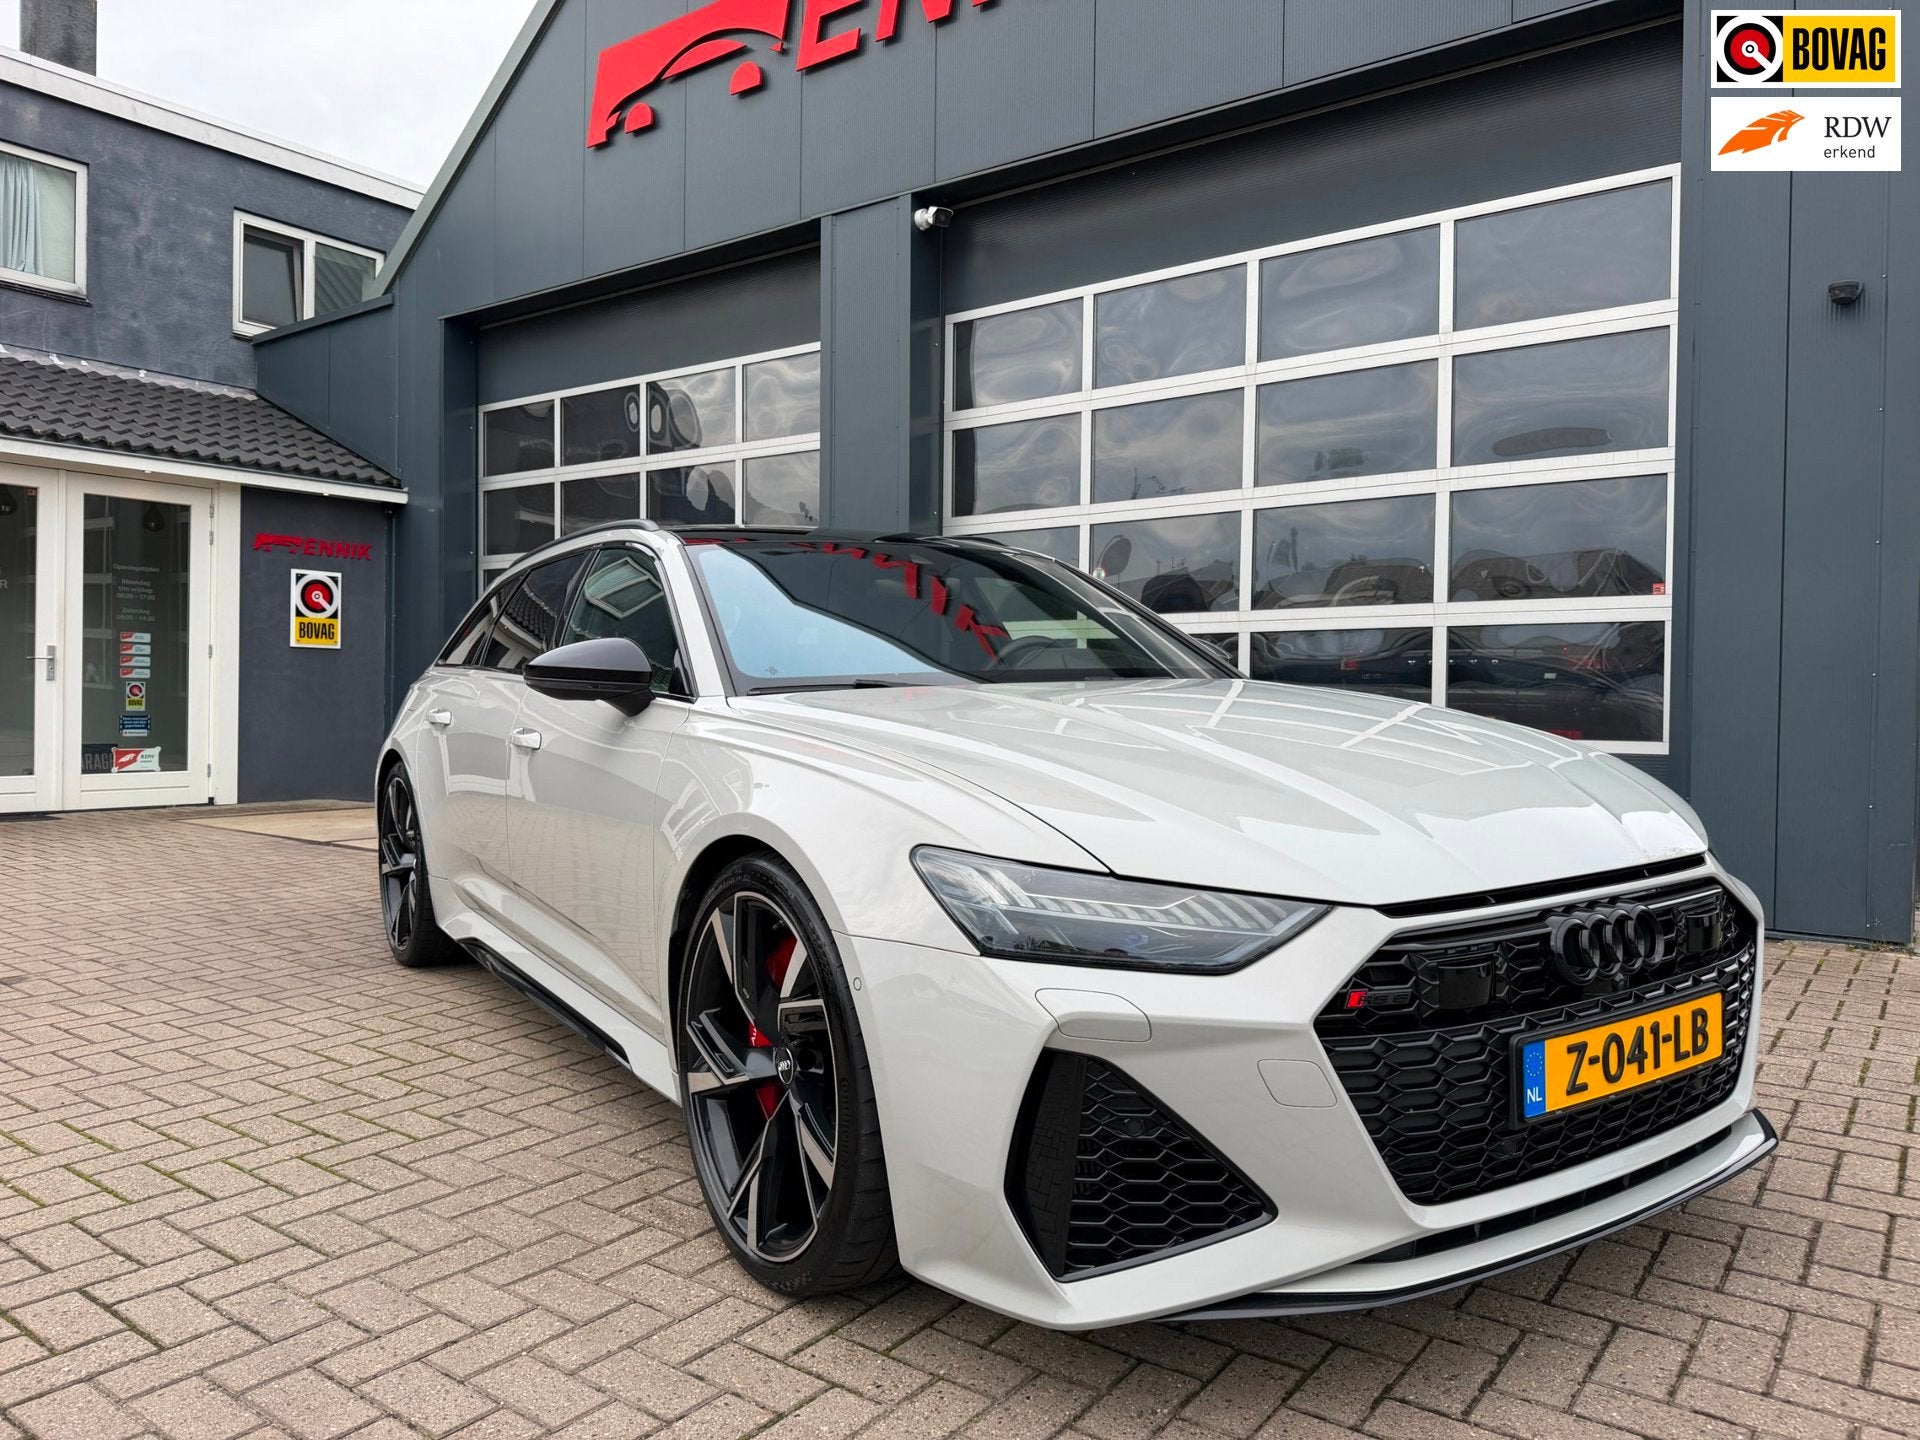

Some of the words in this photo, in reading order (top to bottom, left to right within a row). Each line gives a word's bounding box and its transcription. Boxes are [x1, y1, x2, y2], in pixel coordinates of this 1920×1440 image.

[299, 621, 335, 640] BOVAG
[1566, 1007, 1709, 1096] Z-041-LB
[1527, 1086, 1542, 1104] NL
